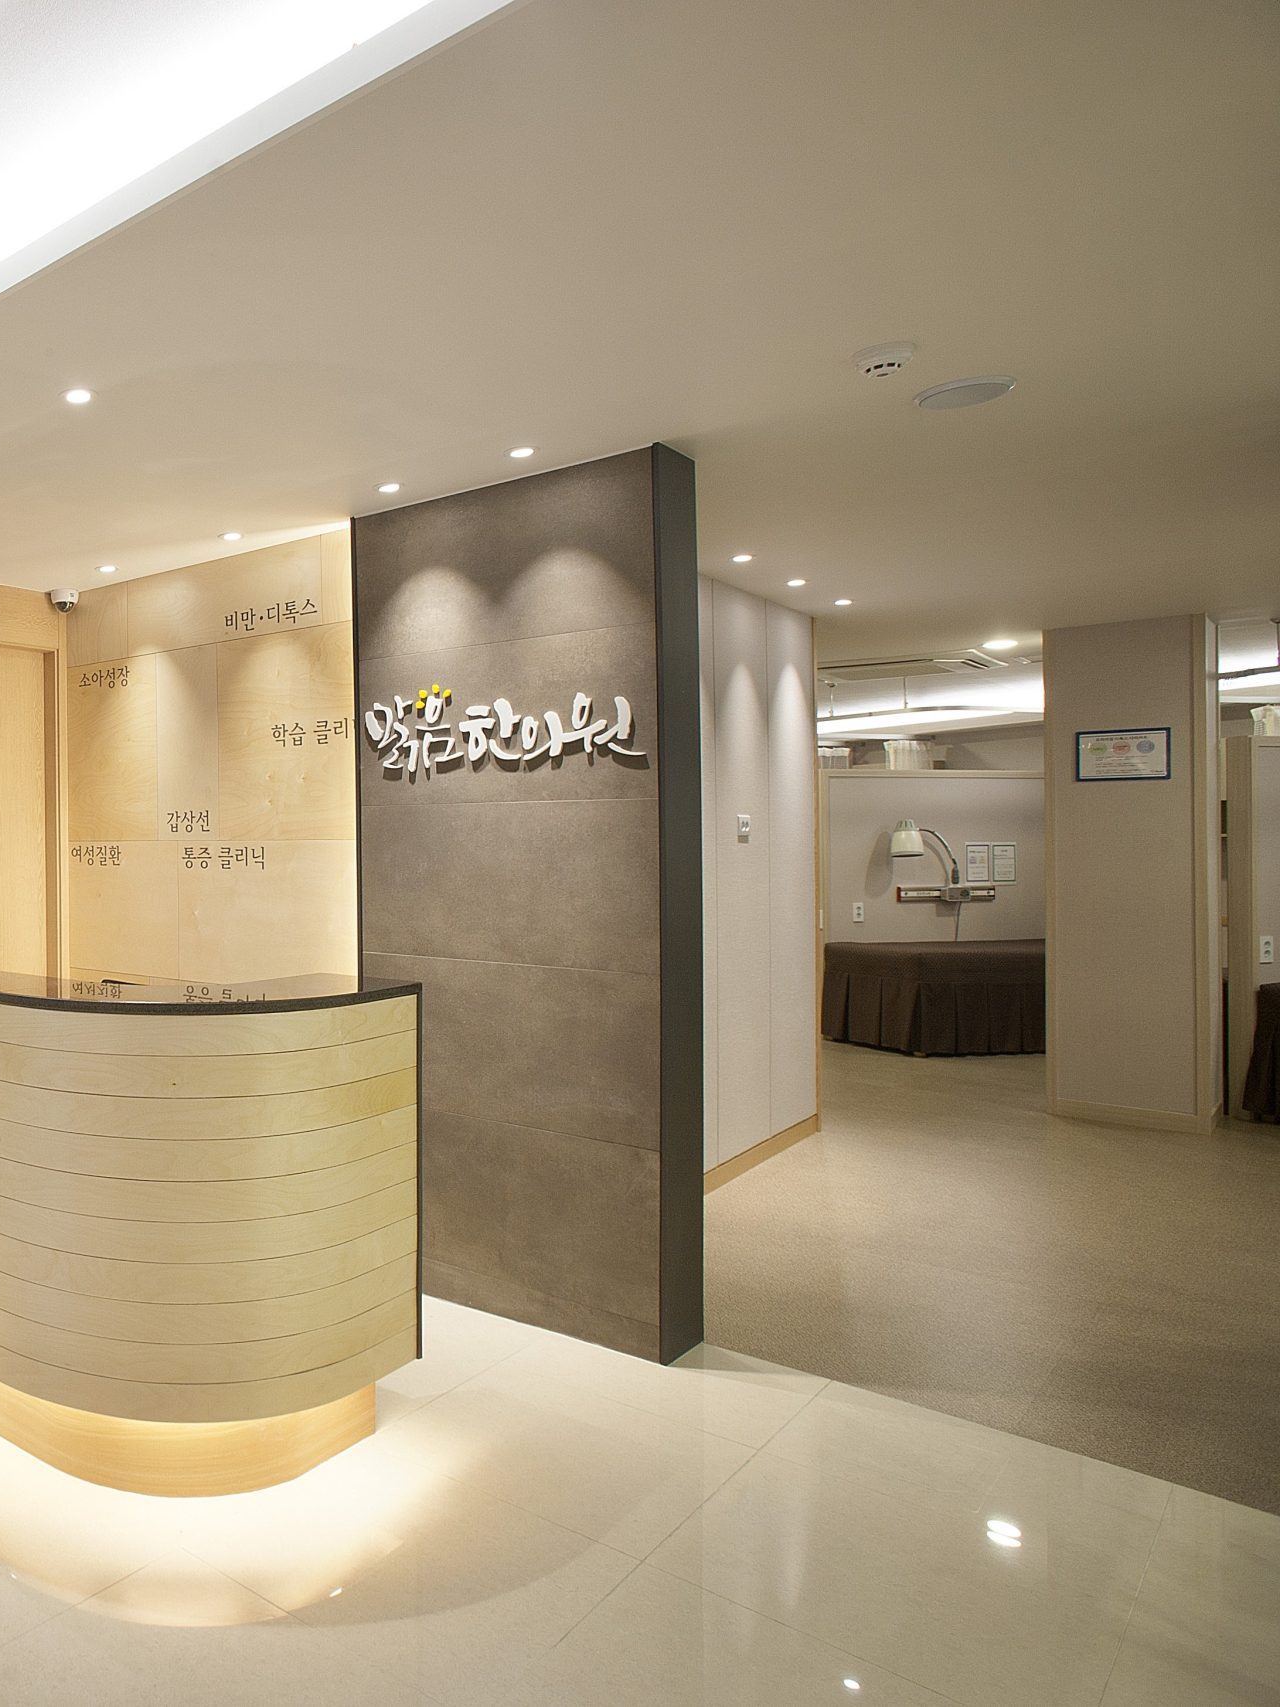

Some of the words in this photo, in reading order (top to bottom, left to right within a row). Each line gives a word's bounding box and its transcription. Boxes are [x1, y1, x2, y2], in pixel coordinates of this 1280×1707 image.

[224, 598, 318, 632] 비만·디톡스
[78, 665, 130, 689] 소아성장
[271, 722, 307, 747] 학습
[312, 716, 355, 745] 클리
[365, 692, 647, 772] 맑음한의원
[166, 810, 210, 833] 갑상선
[70, 845, 121, 866] 여성질환
[181, 847, 212, 869] 통증
[218, 846, 265, 870] 클리닉
